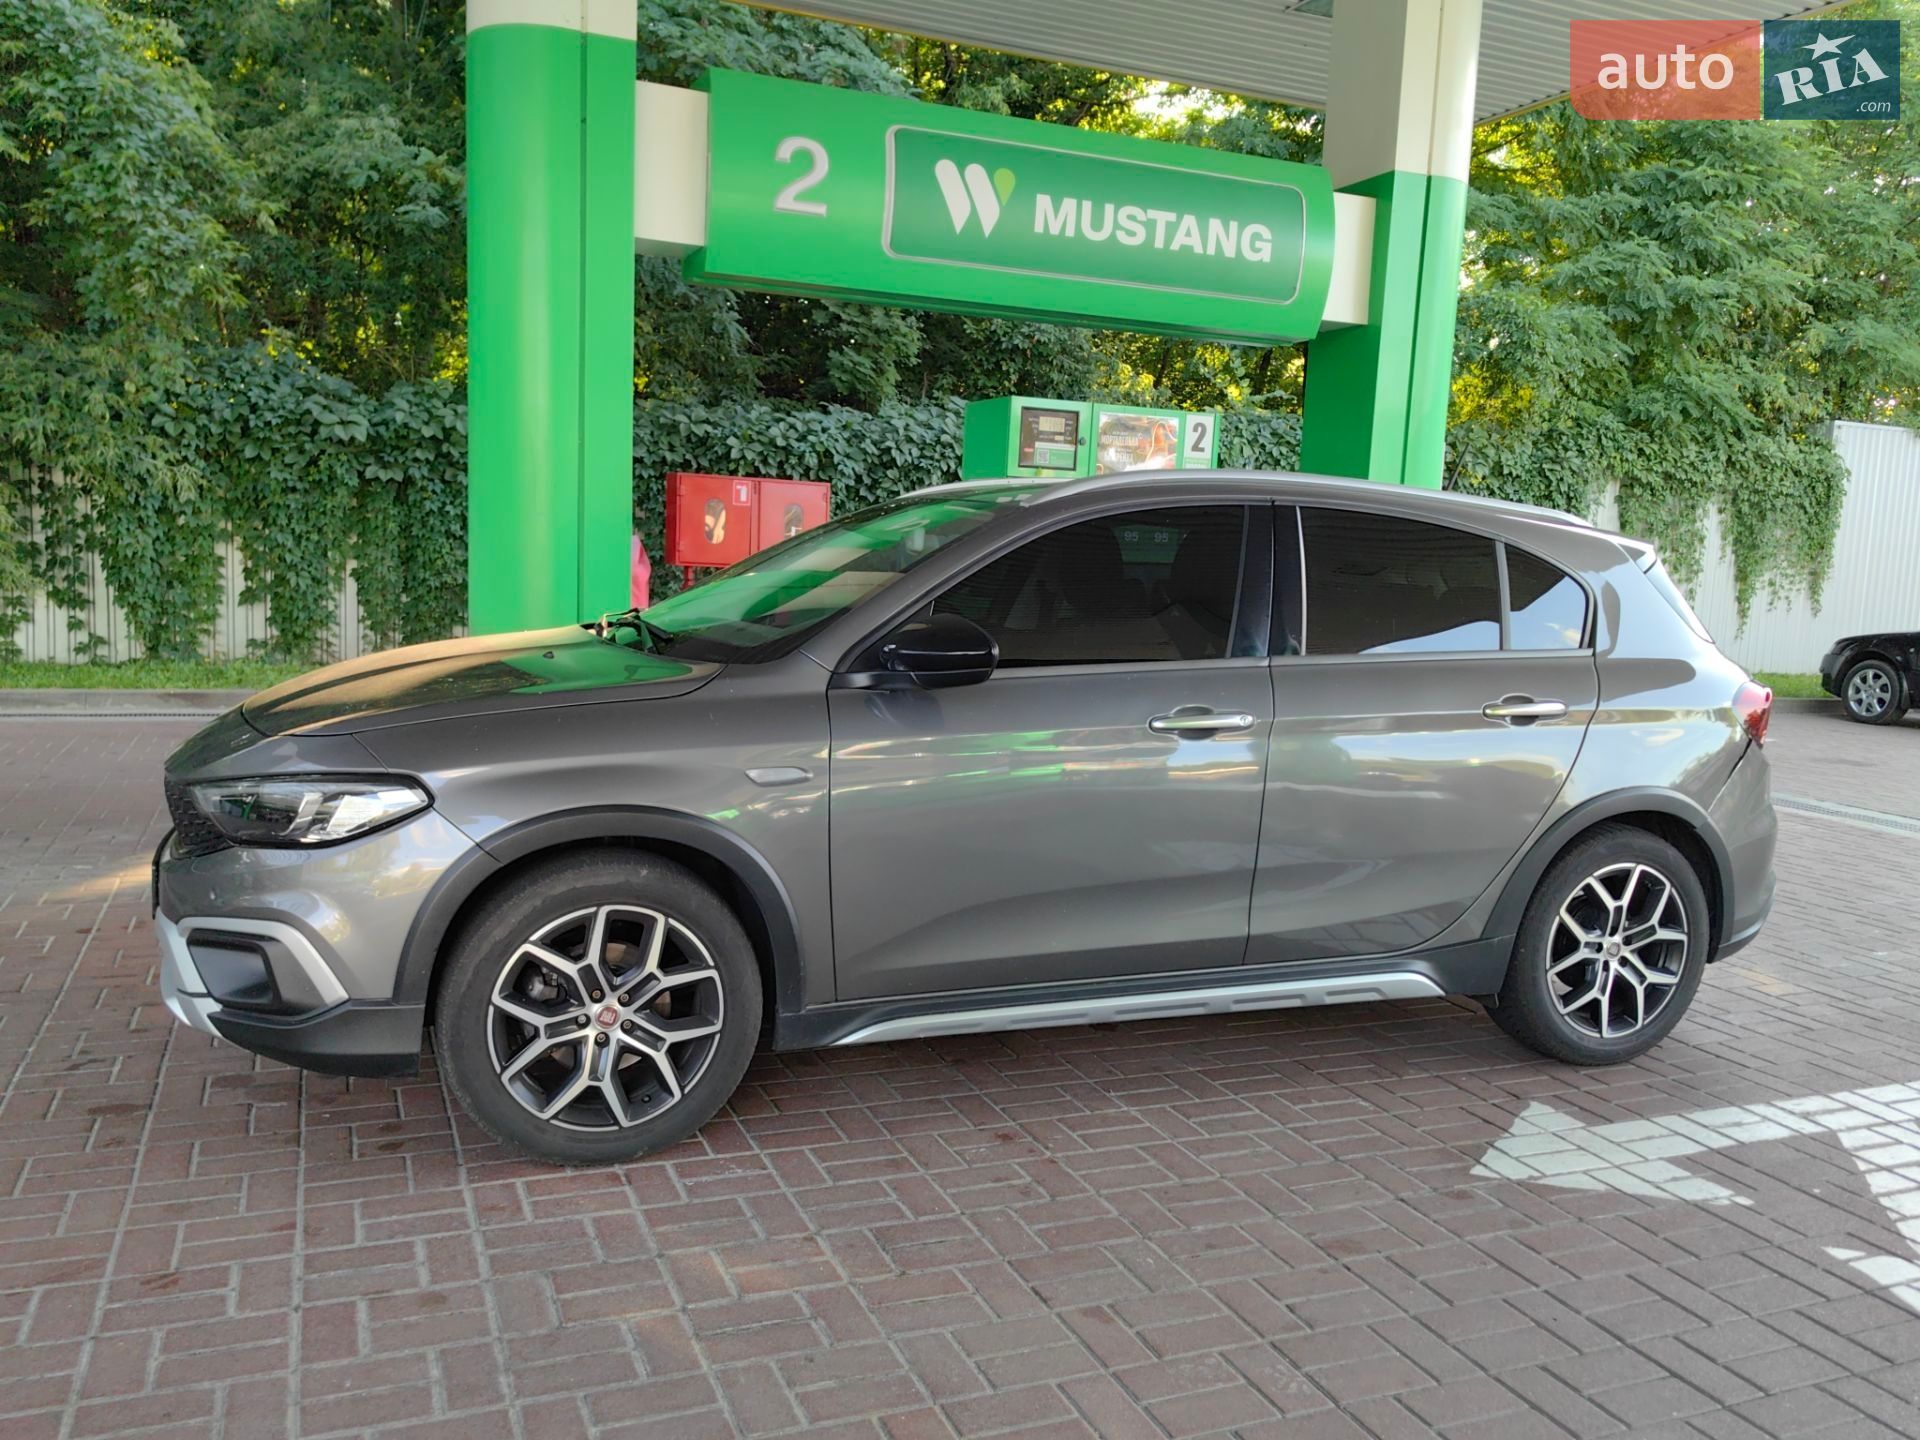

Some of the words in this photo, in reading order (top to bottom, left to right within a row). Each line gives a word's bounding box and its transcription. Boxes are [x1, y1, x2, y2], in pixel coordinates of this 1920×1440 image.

[773, 136, 829, 218] 2
[1034, 194, 1273, 263] MUSTANG
[1191, 422, 1207, 452] 2
[1124, 531, 1139, 541] 95
[1154, 532, 1169, 542] 95
